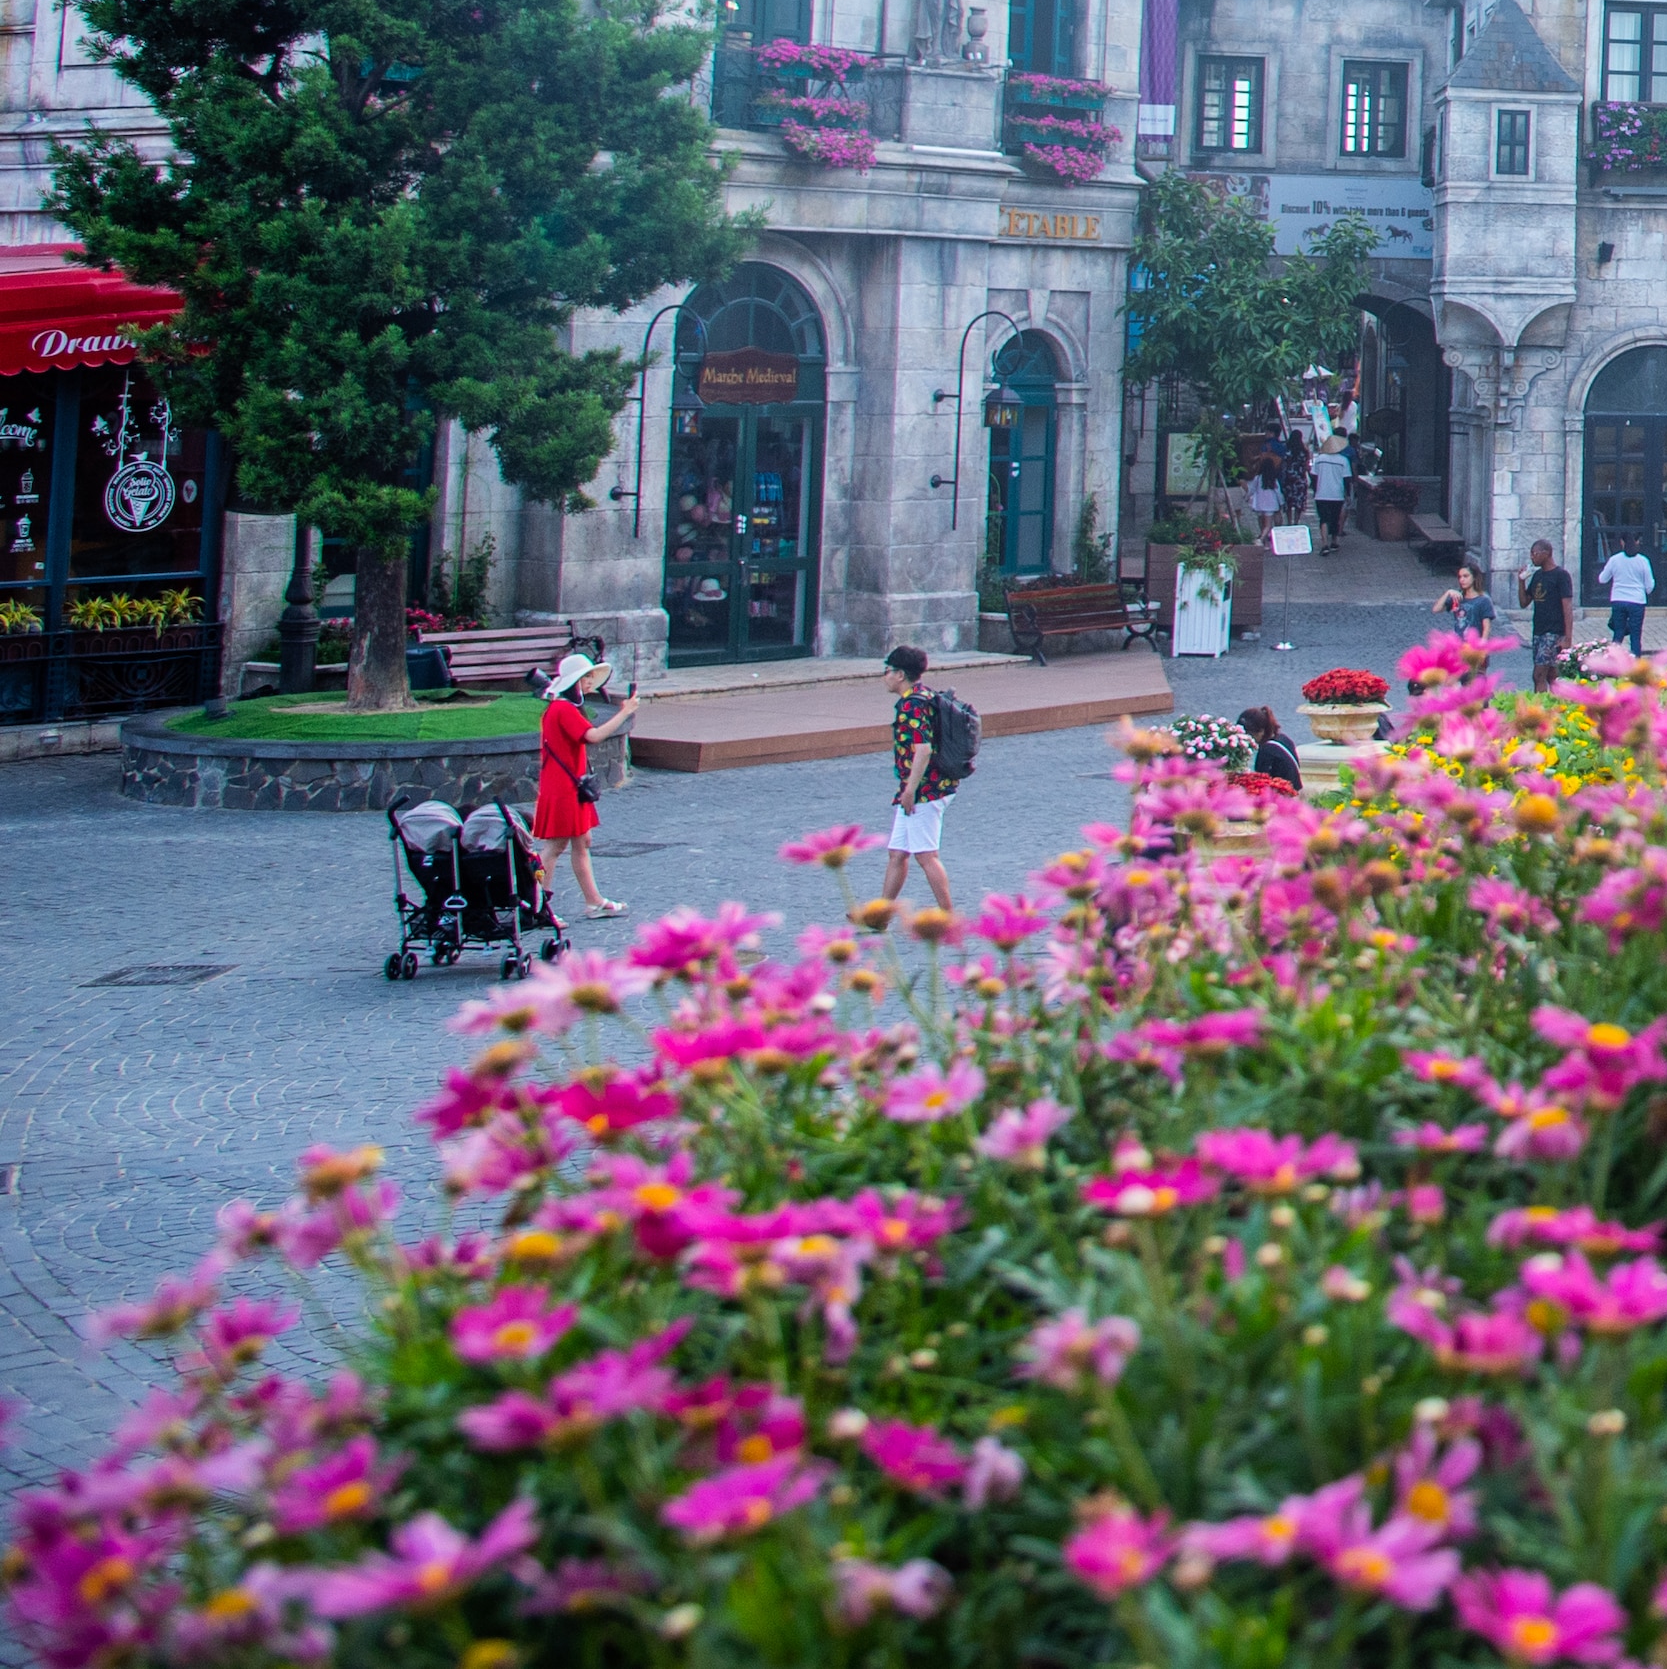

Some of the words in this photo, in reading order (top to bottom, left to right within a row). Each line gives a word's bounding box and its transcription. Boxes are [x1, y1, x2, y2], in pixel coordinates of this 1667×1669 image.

[1281, 203, 1310, 214] Discount
[1312, 200, 1331, 215] 10%
[1333, 205, 1348, 215] with
[1367, 207, 1384, 217] more
[1385, 207, 1400, 217] than
[1401, 206, 1406, 217] 6
[1407, 208, 1430, 219] guests
[32, 329, 138, 358] Draw
[702, 367, 744, 385] Marche
[746, 367, 797, 384] Medieval
